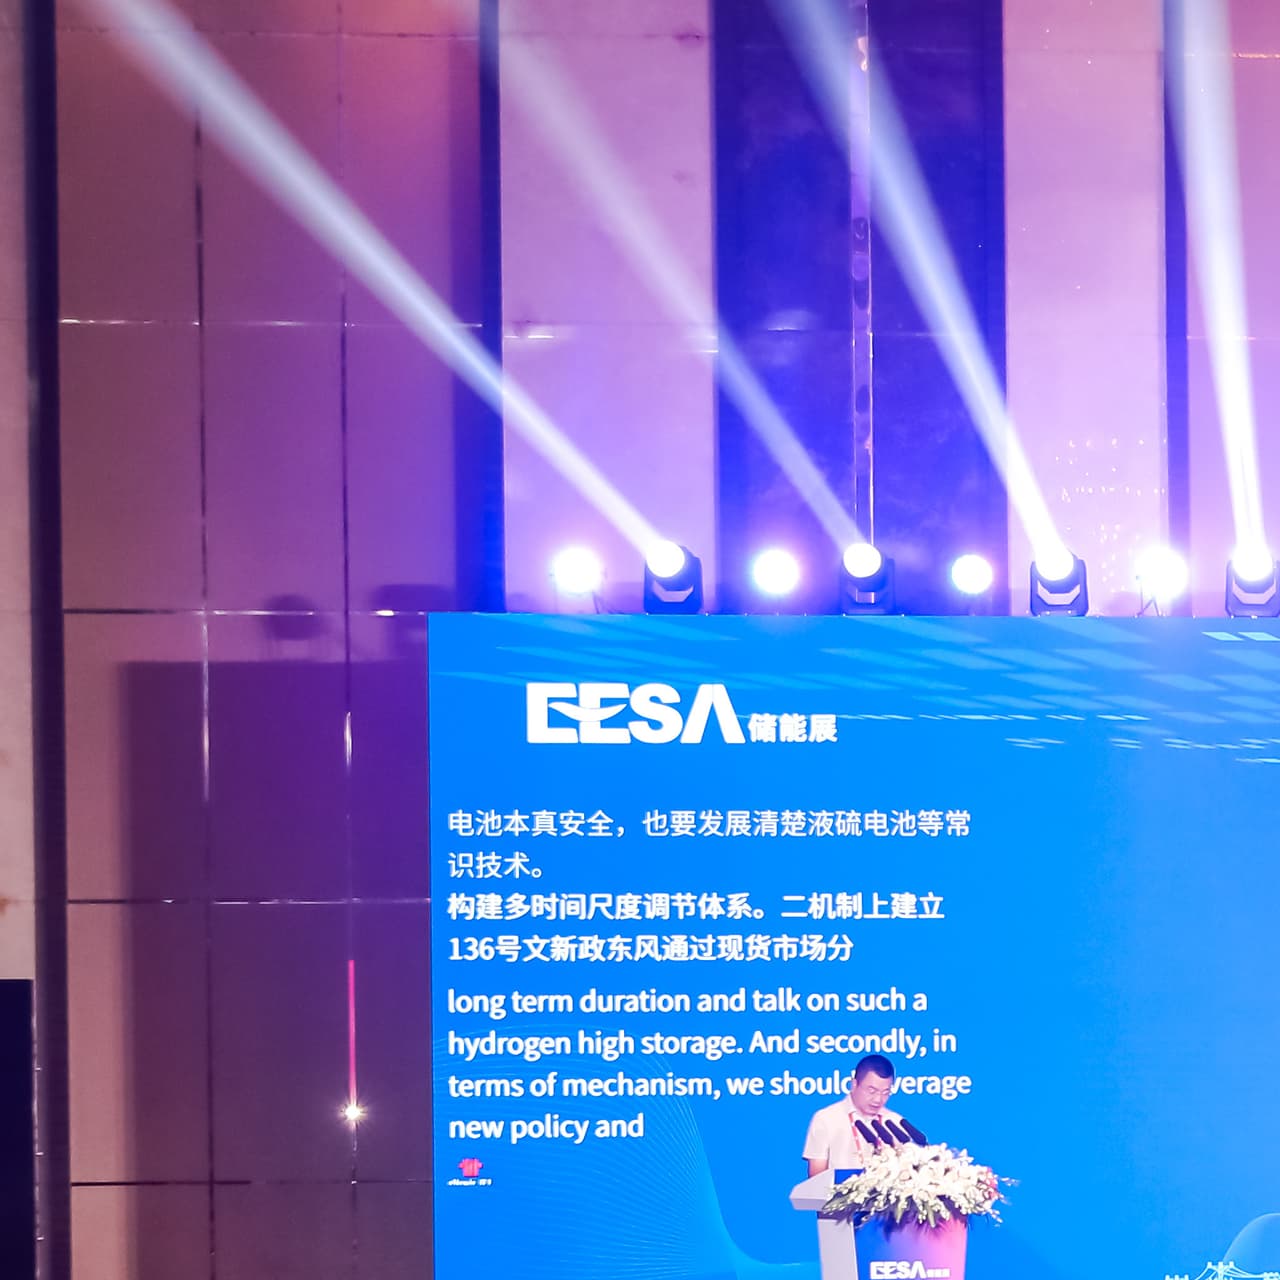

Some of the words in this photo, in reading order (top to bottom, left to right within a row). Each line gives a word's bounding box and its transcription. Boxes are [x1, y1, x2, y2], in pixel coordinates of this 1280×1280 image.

[527, 683, 746, 744] EESA
[748, 713, 838, 743] 储能展
[448, 851, 542, 879] 识技术。
[449, 934, 854, 962] 136号文新政东风通过现货市场分
[448, 988, 507, 1020] long
[512, 991, 573, 1013] term
[579, 988, 690, 1013] duration
[697, 987, 746, 1012] and
[752, 987, 801, 1012] talk
[806, 993, 840, 1012] on
[846, 986, 906, 1011] such
[912, 993, 927, 1011] a
[448, 1030, 571, 1062] hydrogen
[578, 1029, 635, 1061] high
[641, 1032, 743, 1061] storage.
[749, 1028, 800, 1054] And
[806, 1028, 927, 1059] secondly,
[933, 1028, 957, 1052] in
[448, 1075, 524, 1098] terms
[530, 1071, 558, 1097] of
[563, 1071, 721, 1100] mechanism,
[726, 1077, 764, 1095] we
[449, 1120, 505, 1139] new
[511, 1113, 589, 1145] policy
[595, 1112, 644, 1138] and
[869, 1261, 927, 1280] EESA
